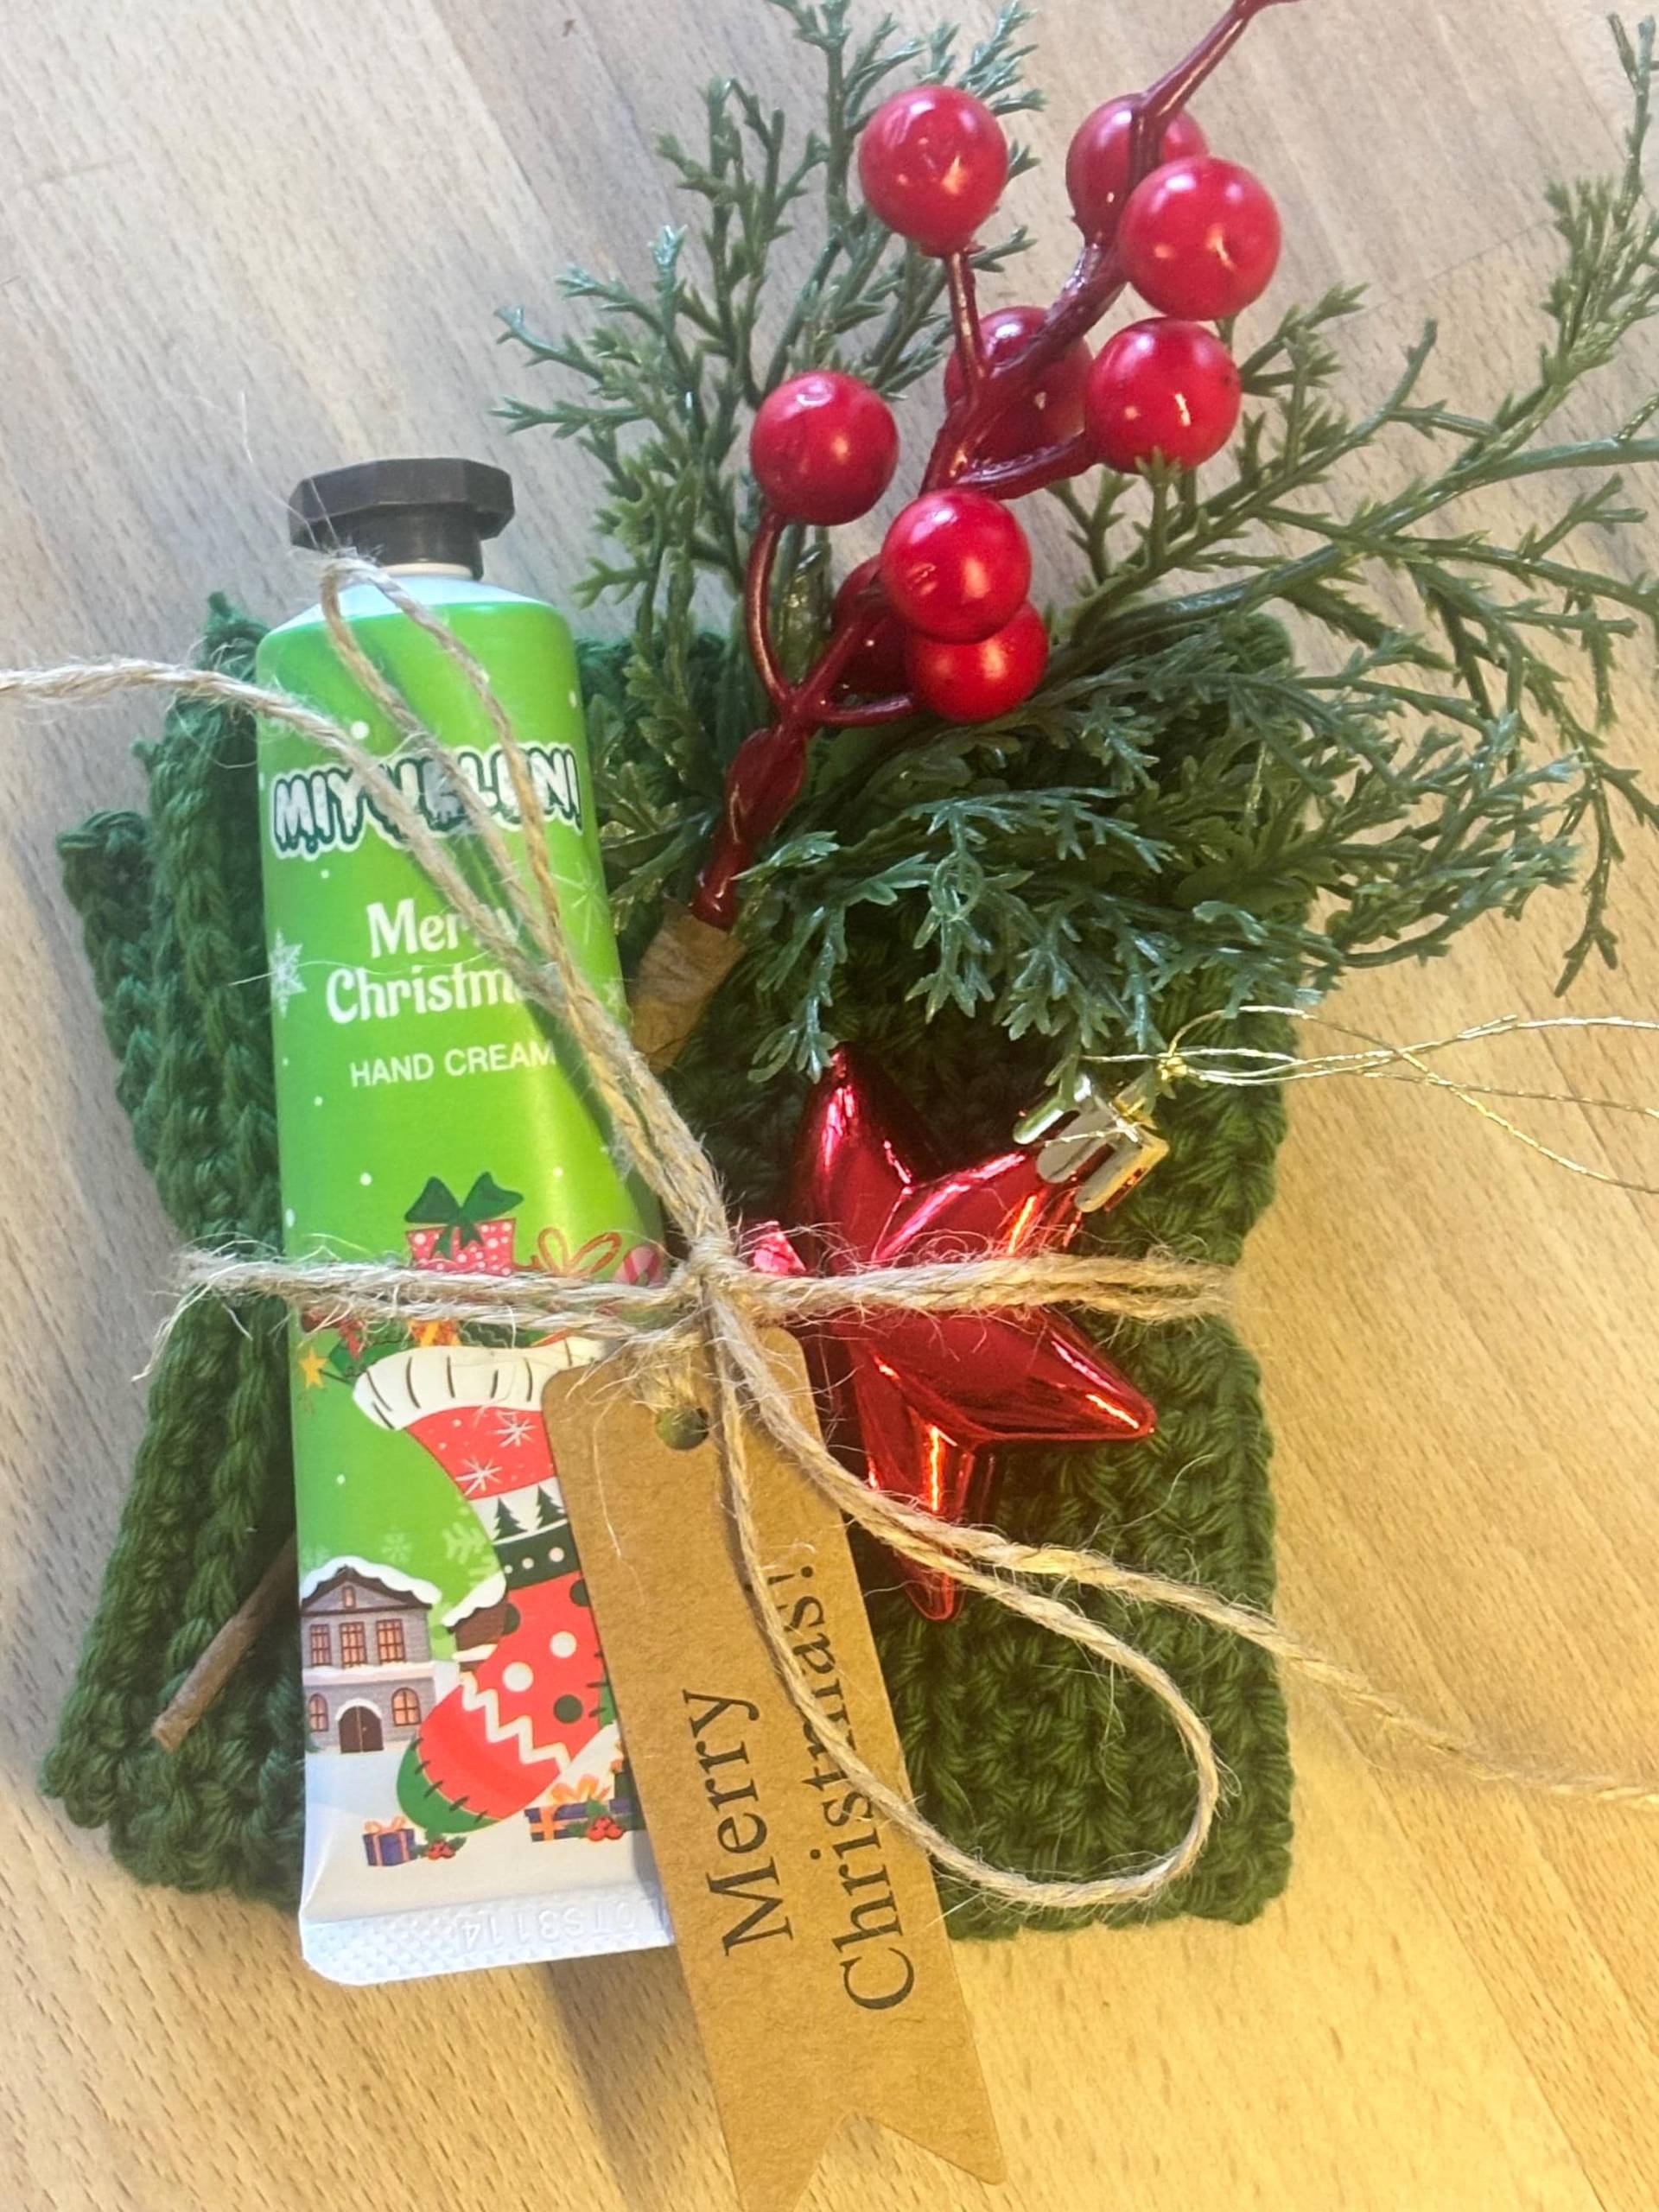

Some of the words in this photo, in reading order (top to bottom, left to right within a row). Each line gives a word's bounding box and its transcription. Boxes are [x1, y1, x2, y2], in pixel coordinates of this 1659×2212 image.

[366, 898, 519, 959] Mer
[326, 962, 525, 1025] Christm
[349, 1052, 435, 1088] HAND
[444, 1039, 557, 1077] CREAM
[682, 1688, 793, 1957] Merry
